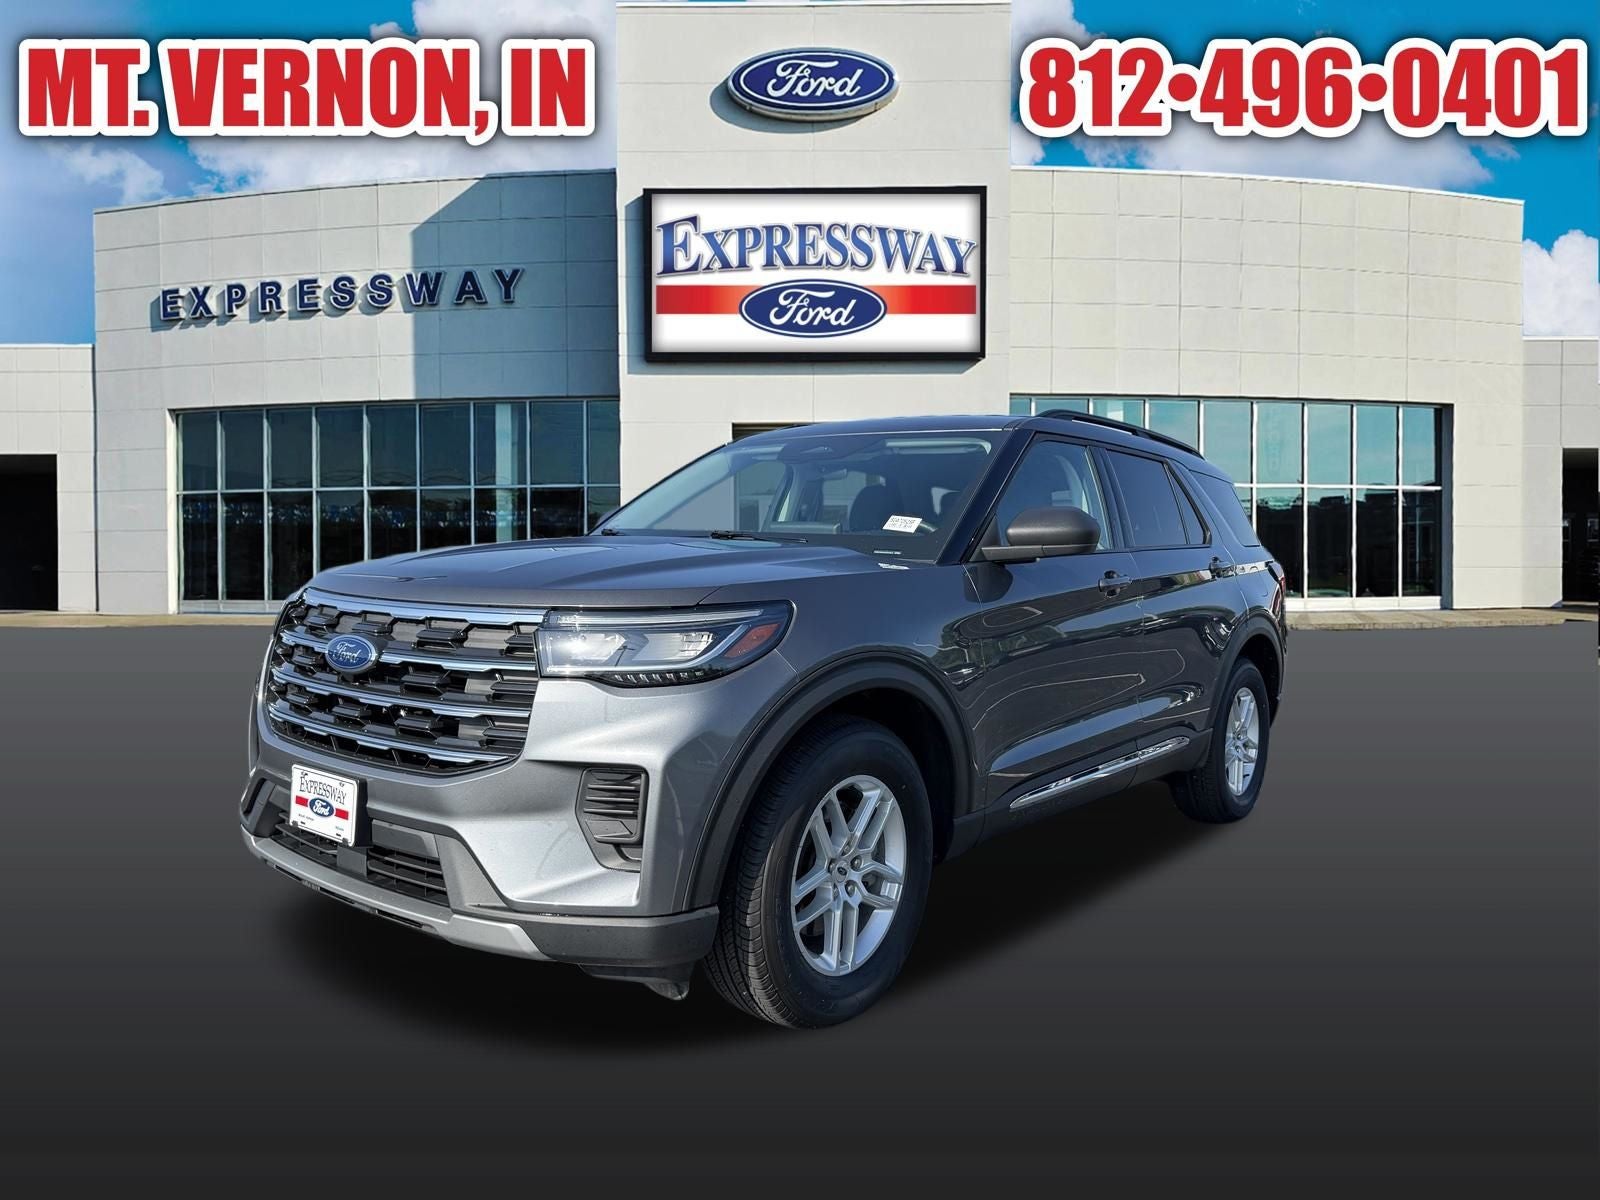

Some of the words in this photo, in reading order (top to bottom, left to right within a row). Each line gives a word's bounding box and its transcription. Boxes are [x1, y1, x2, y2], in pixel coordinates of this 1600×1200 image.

[766, 59, 863, 98] Ford
[656, 213, 977, 278] EXPRESSWAY
[159, 267, 525, 322] EXPRESSWAY
[769, 288, 857, 327] Ford
[299, 775, 347, 806] EXPRESSWAY
[312, 799, 331, 817] Ford
